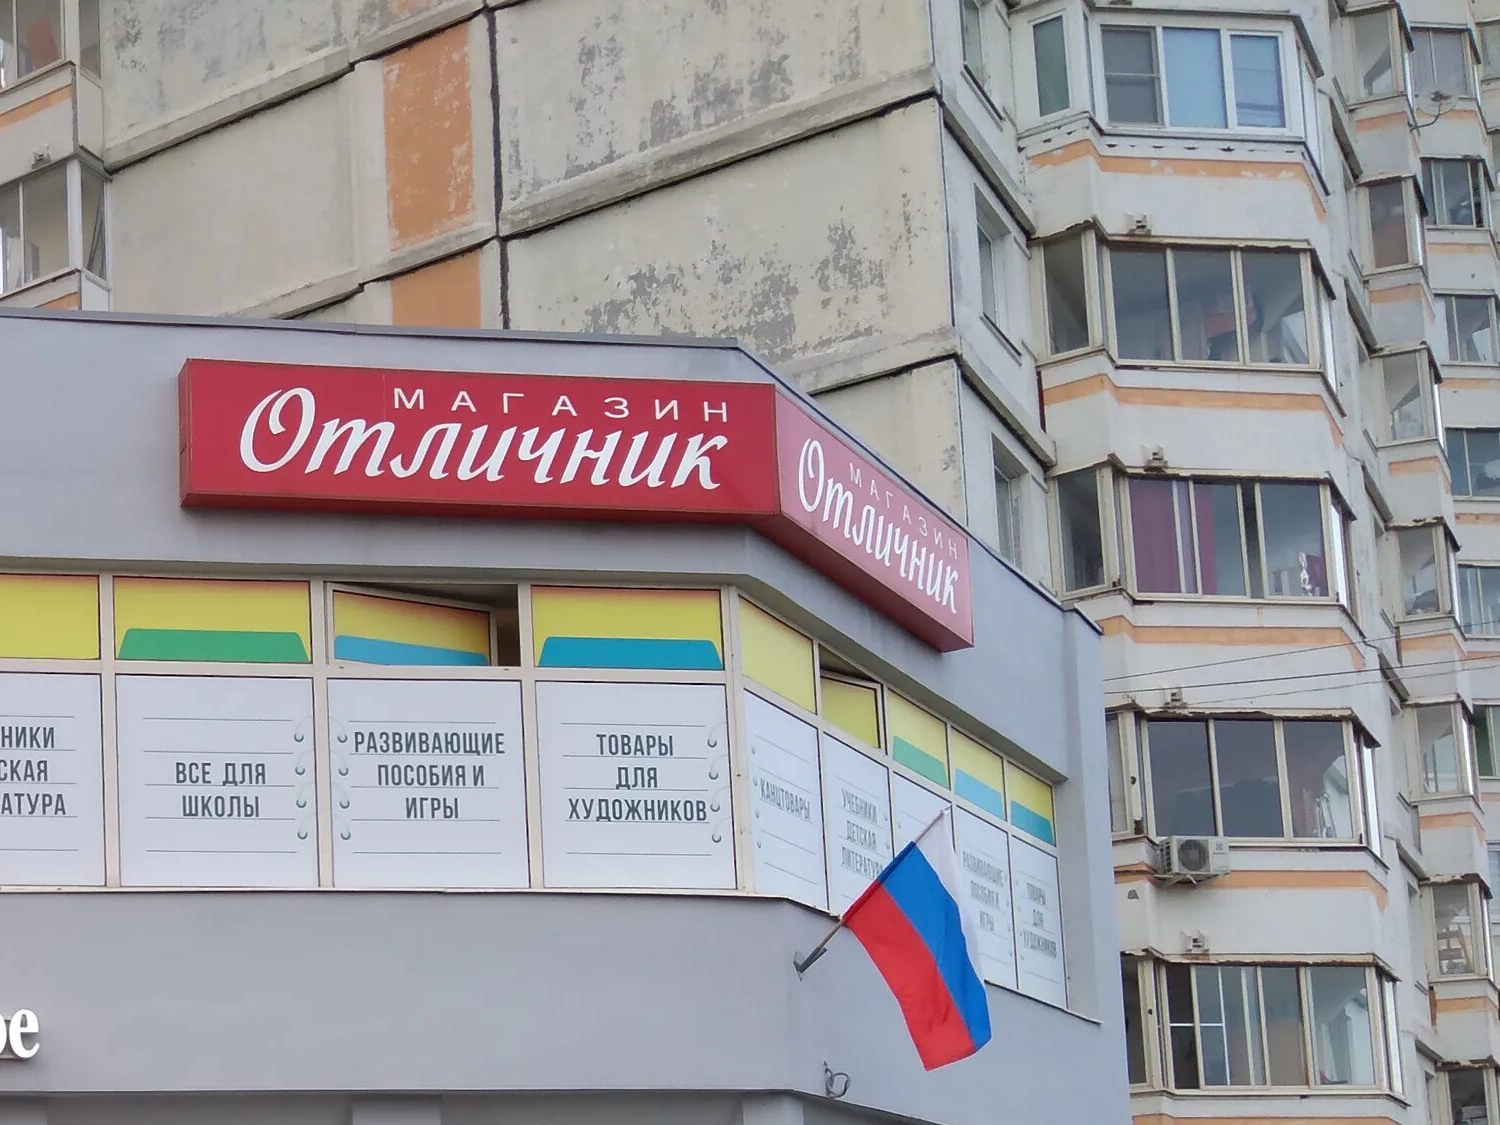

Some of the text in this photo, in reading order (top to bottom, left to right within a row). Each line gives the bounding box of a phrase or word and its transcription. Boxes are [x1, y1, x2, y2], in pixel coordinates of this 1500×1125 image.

[393, 387, 728, 423] МАГАЗИН
[239, 387, 728, 491] Отличник
[849, 462, 958, 560] МАГАЗИН
[798, 437, 959, 614] Отличник
[354, 731, 506, 756] РАЗВИВАЮЩИЕ
[596, 733, 674, 757] ТОВАРЫ
[175, 761, 266, 787] ВСЕ ДЛЯ
[377, 764, 485, 788] ПОСОБИЯ И
[615, 766, 658, 790] ДЛЯ
[182, 795, 260, 818] ШКОЛЫ
[405, 796, 460, 820] ИГРЫ
[568, 797, 708, 822] ХУДОЖНИКОВ
[760, 778, 811, 821] КАНЦТОВАРЫ
